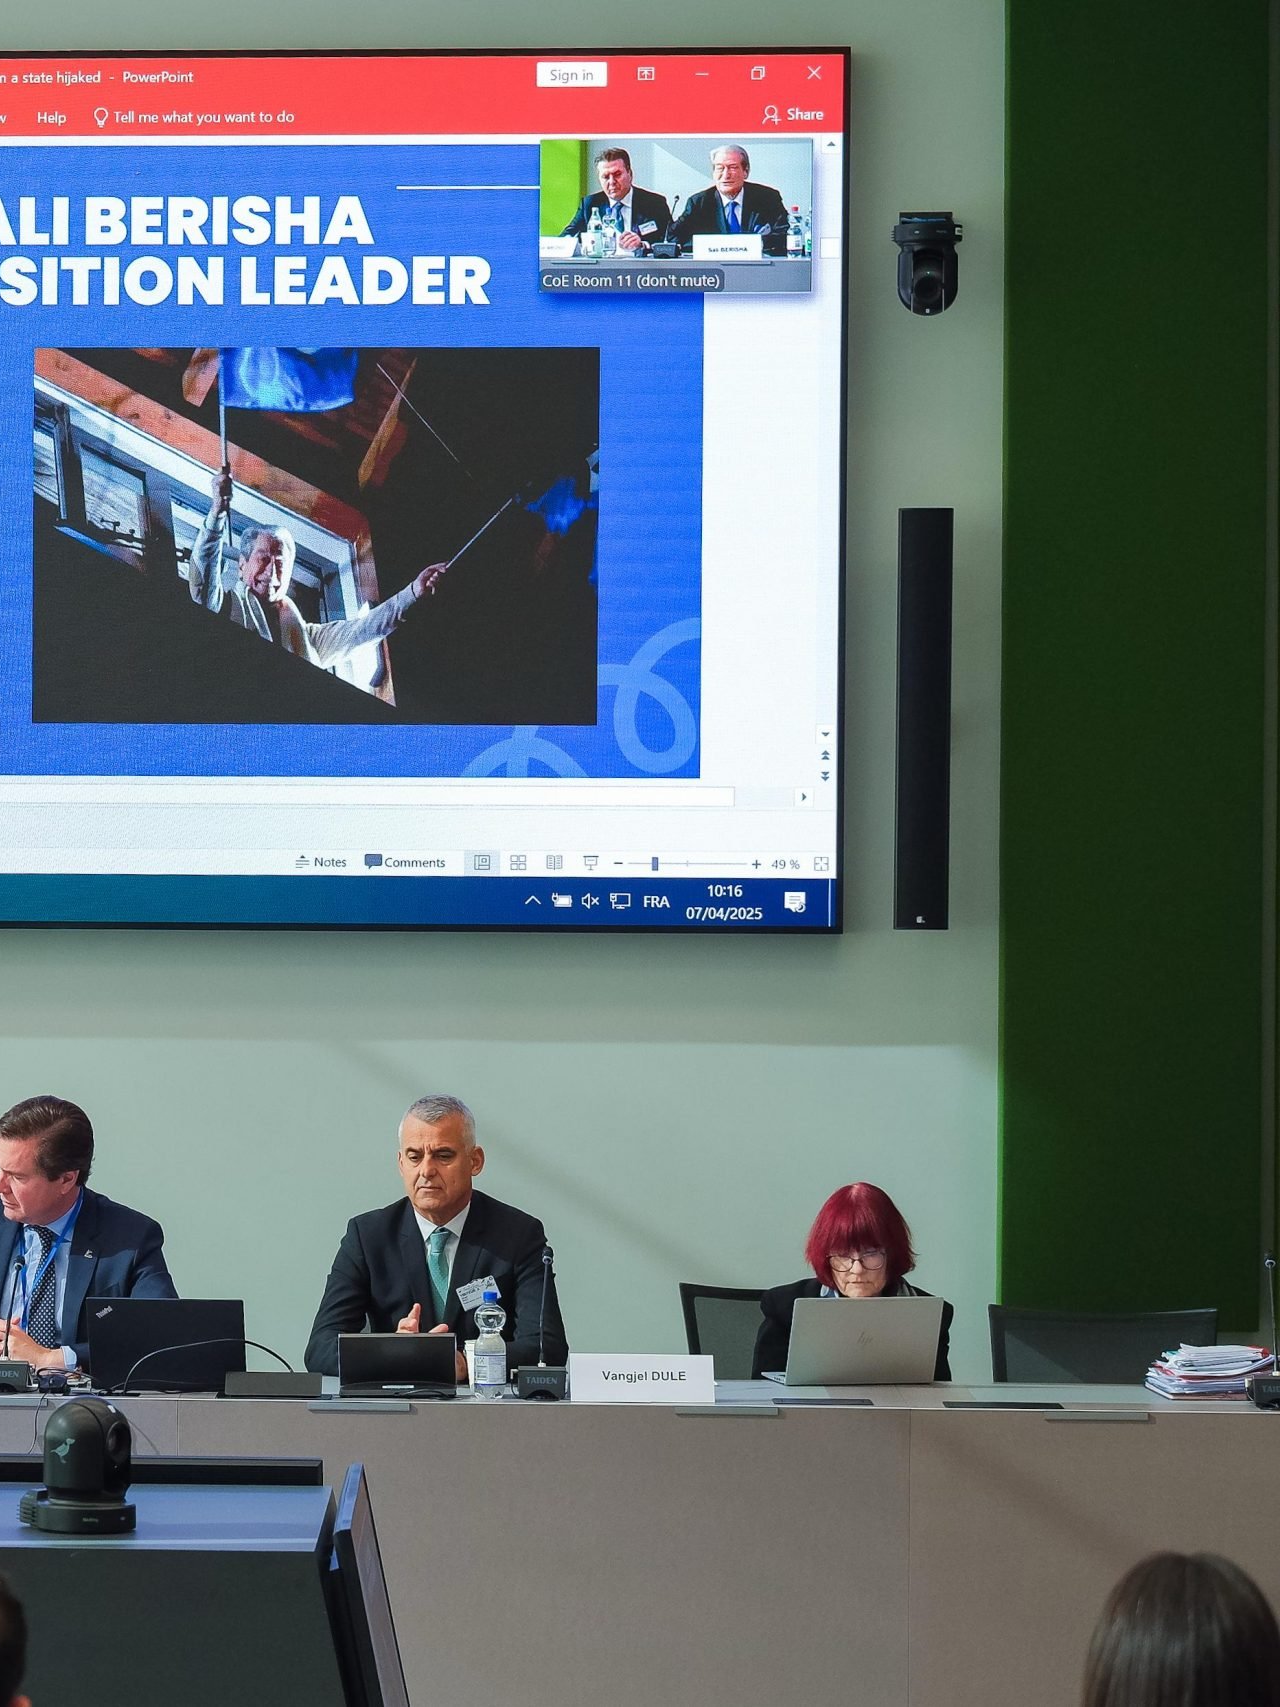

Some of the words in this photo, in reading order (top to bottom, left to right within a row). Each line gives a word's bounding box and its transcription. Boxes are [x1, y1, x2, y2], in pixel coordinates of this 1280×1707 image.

[11, 75, 18, 83] a
[23, 73, 53, 84] state
[56, 71, 101, 86] hijaked
[123, 71, 193, 82] PowerPoint
[550, 69, 578, 83] Sign
[582, 69, 594, 81] in
[38, 111, 66, 126] Help
[114, 111, 134, 123] Tell
[138, 114, 158, 123] me
[162, 111, 193, 123] what
[197, 114, 221, 126] you
[224, 112, 255, 122] want
[259, 112, 273, 122] to
[276, 110, 294, 122] do
[787, 108, 824, 121] Share
[84, 195, 375, 246] BERISHA
[240, 255, 492, 308] LEADER
[543, 275, 569, 287] CoE
[574, 275, 612, 286] Room
[617, 275, 630, 286] 11
[637, 274, 677, 289] (don't
[681, 274, 719, 288] mute)
[315, 858, 346, 867] Notes
[385, 858, 445, 867] Comments
[771, 860, 786, 869] 49
[790, 859, 800, 869] %
[708, 885, 742, 897] 10:16
[644, 896, 670, 907] FRA
[686, 907, 762, 921] 07/04/2025
[526, 1376, 558, 1385] TAIDEN
[602, 1371, 647, 1383] Vangjel
[652, 1372, 686, 1380] DULE
